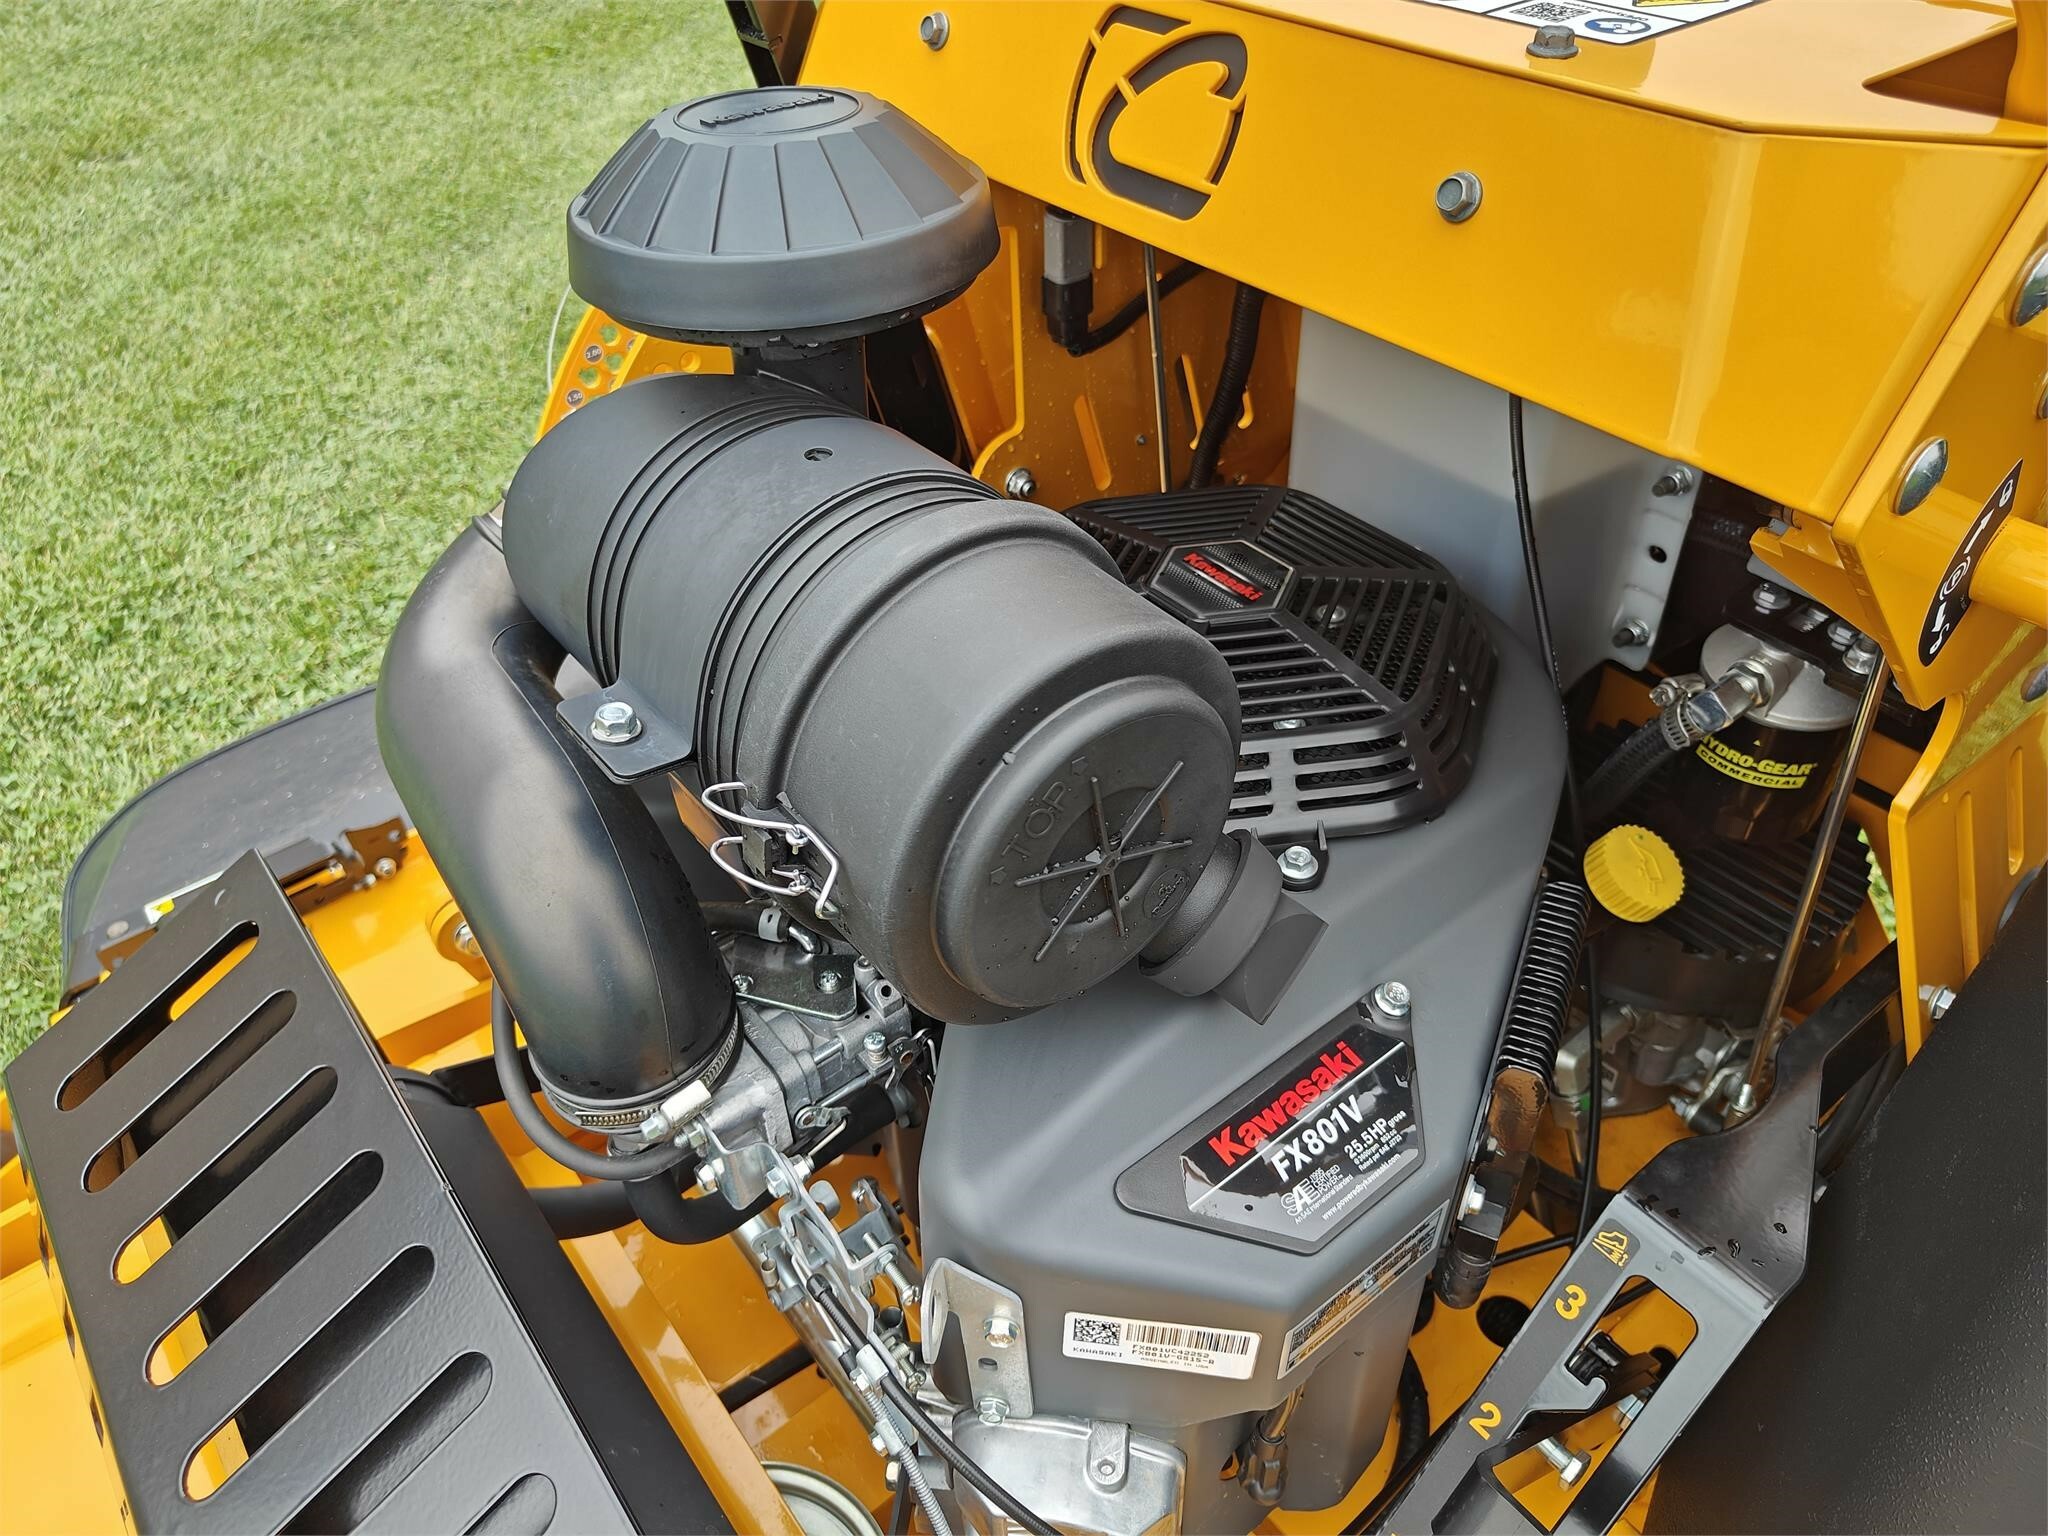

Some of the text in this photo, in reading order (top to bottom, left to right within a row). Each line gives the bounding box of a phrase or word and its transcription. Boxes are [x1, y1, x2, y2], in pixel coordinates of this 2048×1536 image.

[1183, 553, 1264, 601] Kawasaki
[1700, 749, 1800, 785] COMMERCIAL
[1001, 781, 1066, 859] TOP
[1208, 1041, 1364, 1167] Kawasaki
[1270, 1095, 1364, 1183] FX801V
[1313, 1164, 1341, 1189] CERTIFIED
[1322, 1154, 1401, 1220] www.poweredbykawasaki.com
[1555, 1284, 1587, 1320] 3
[1073, 1346, 1123, 1358] KAWASAKI
[1468, 1402, 1502, 1441] 2
